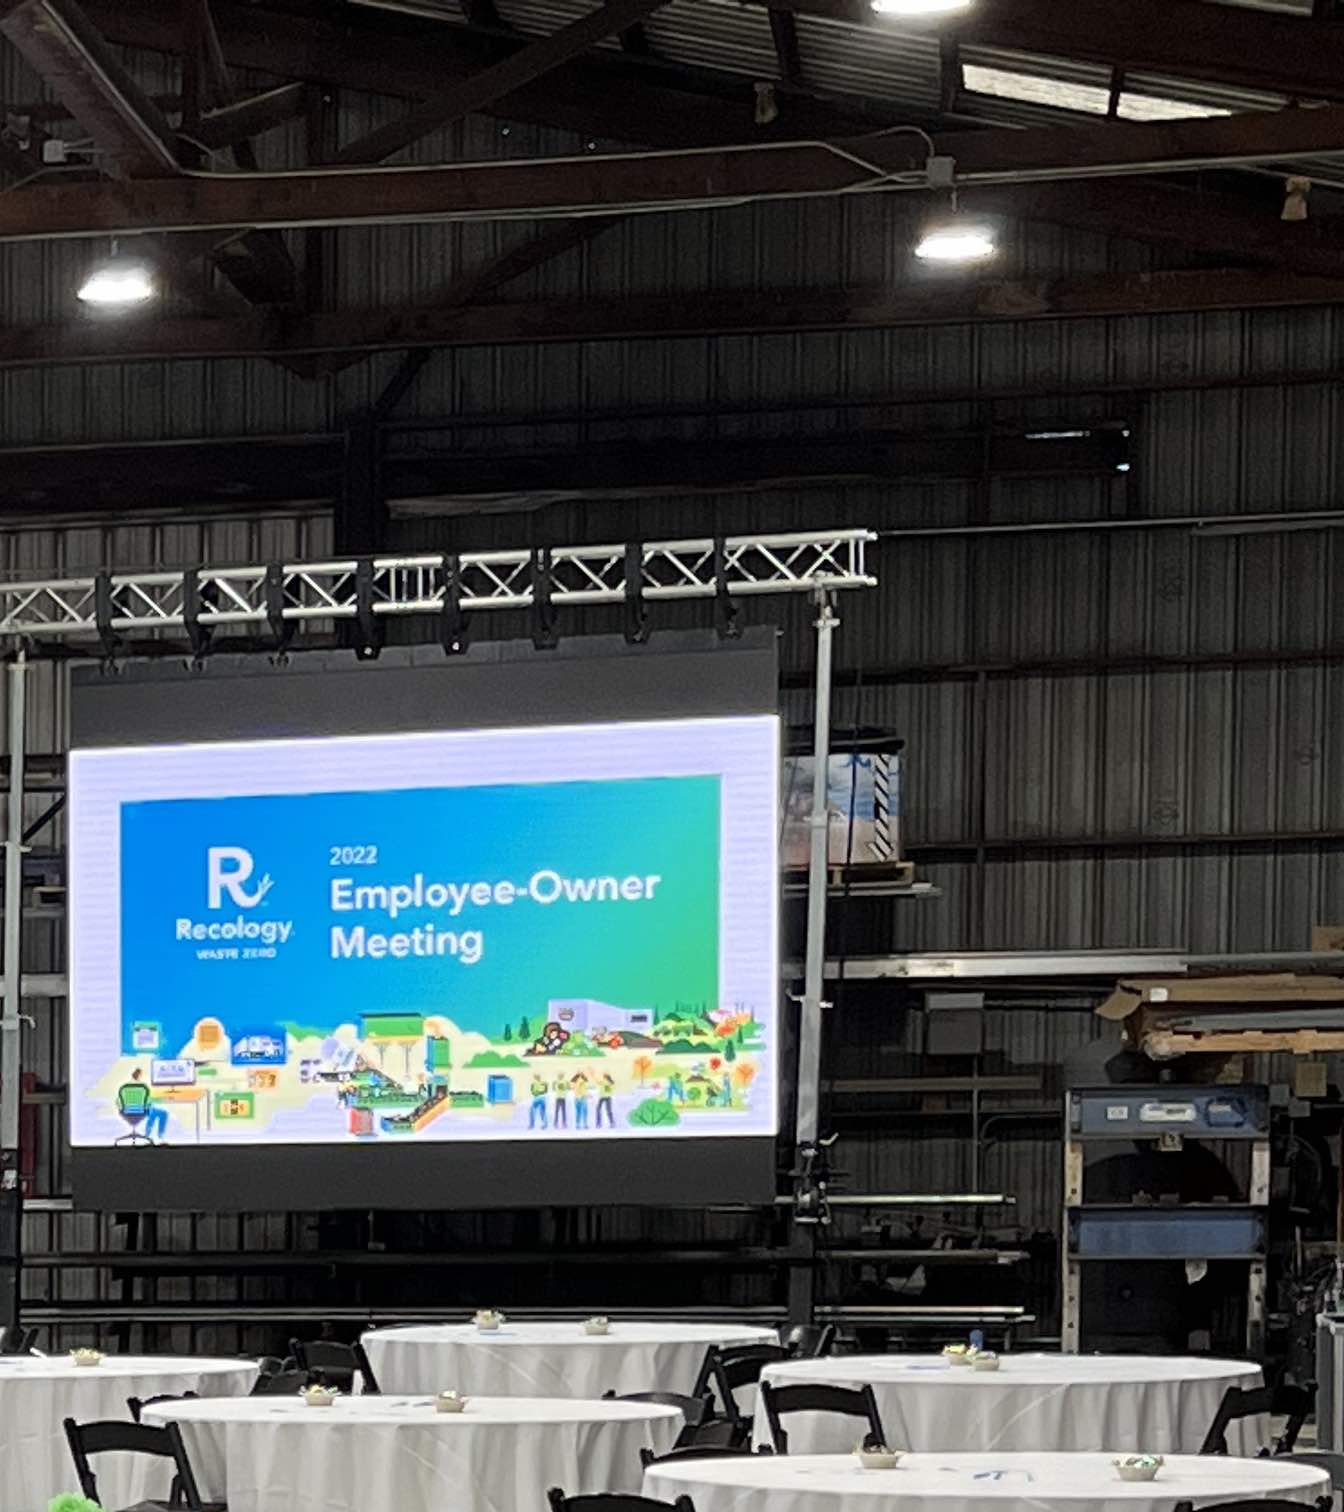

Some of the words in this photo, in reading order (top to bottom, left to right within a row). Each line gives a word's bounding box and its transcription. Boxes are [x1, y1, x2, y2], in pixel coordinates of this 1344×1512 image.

[329, 845, 378, 866] 2022
[330, 869, 662, 918] Employee-Owner
[175, 914, 293, 945] Recology
[330, 923, 484, 964] Meeting
